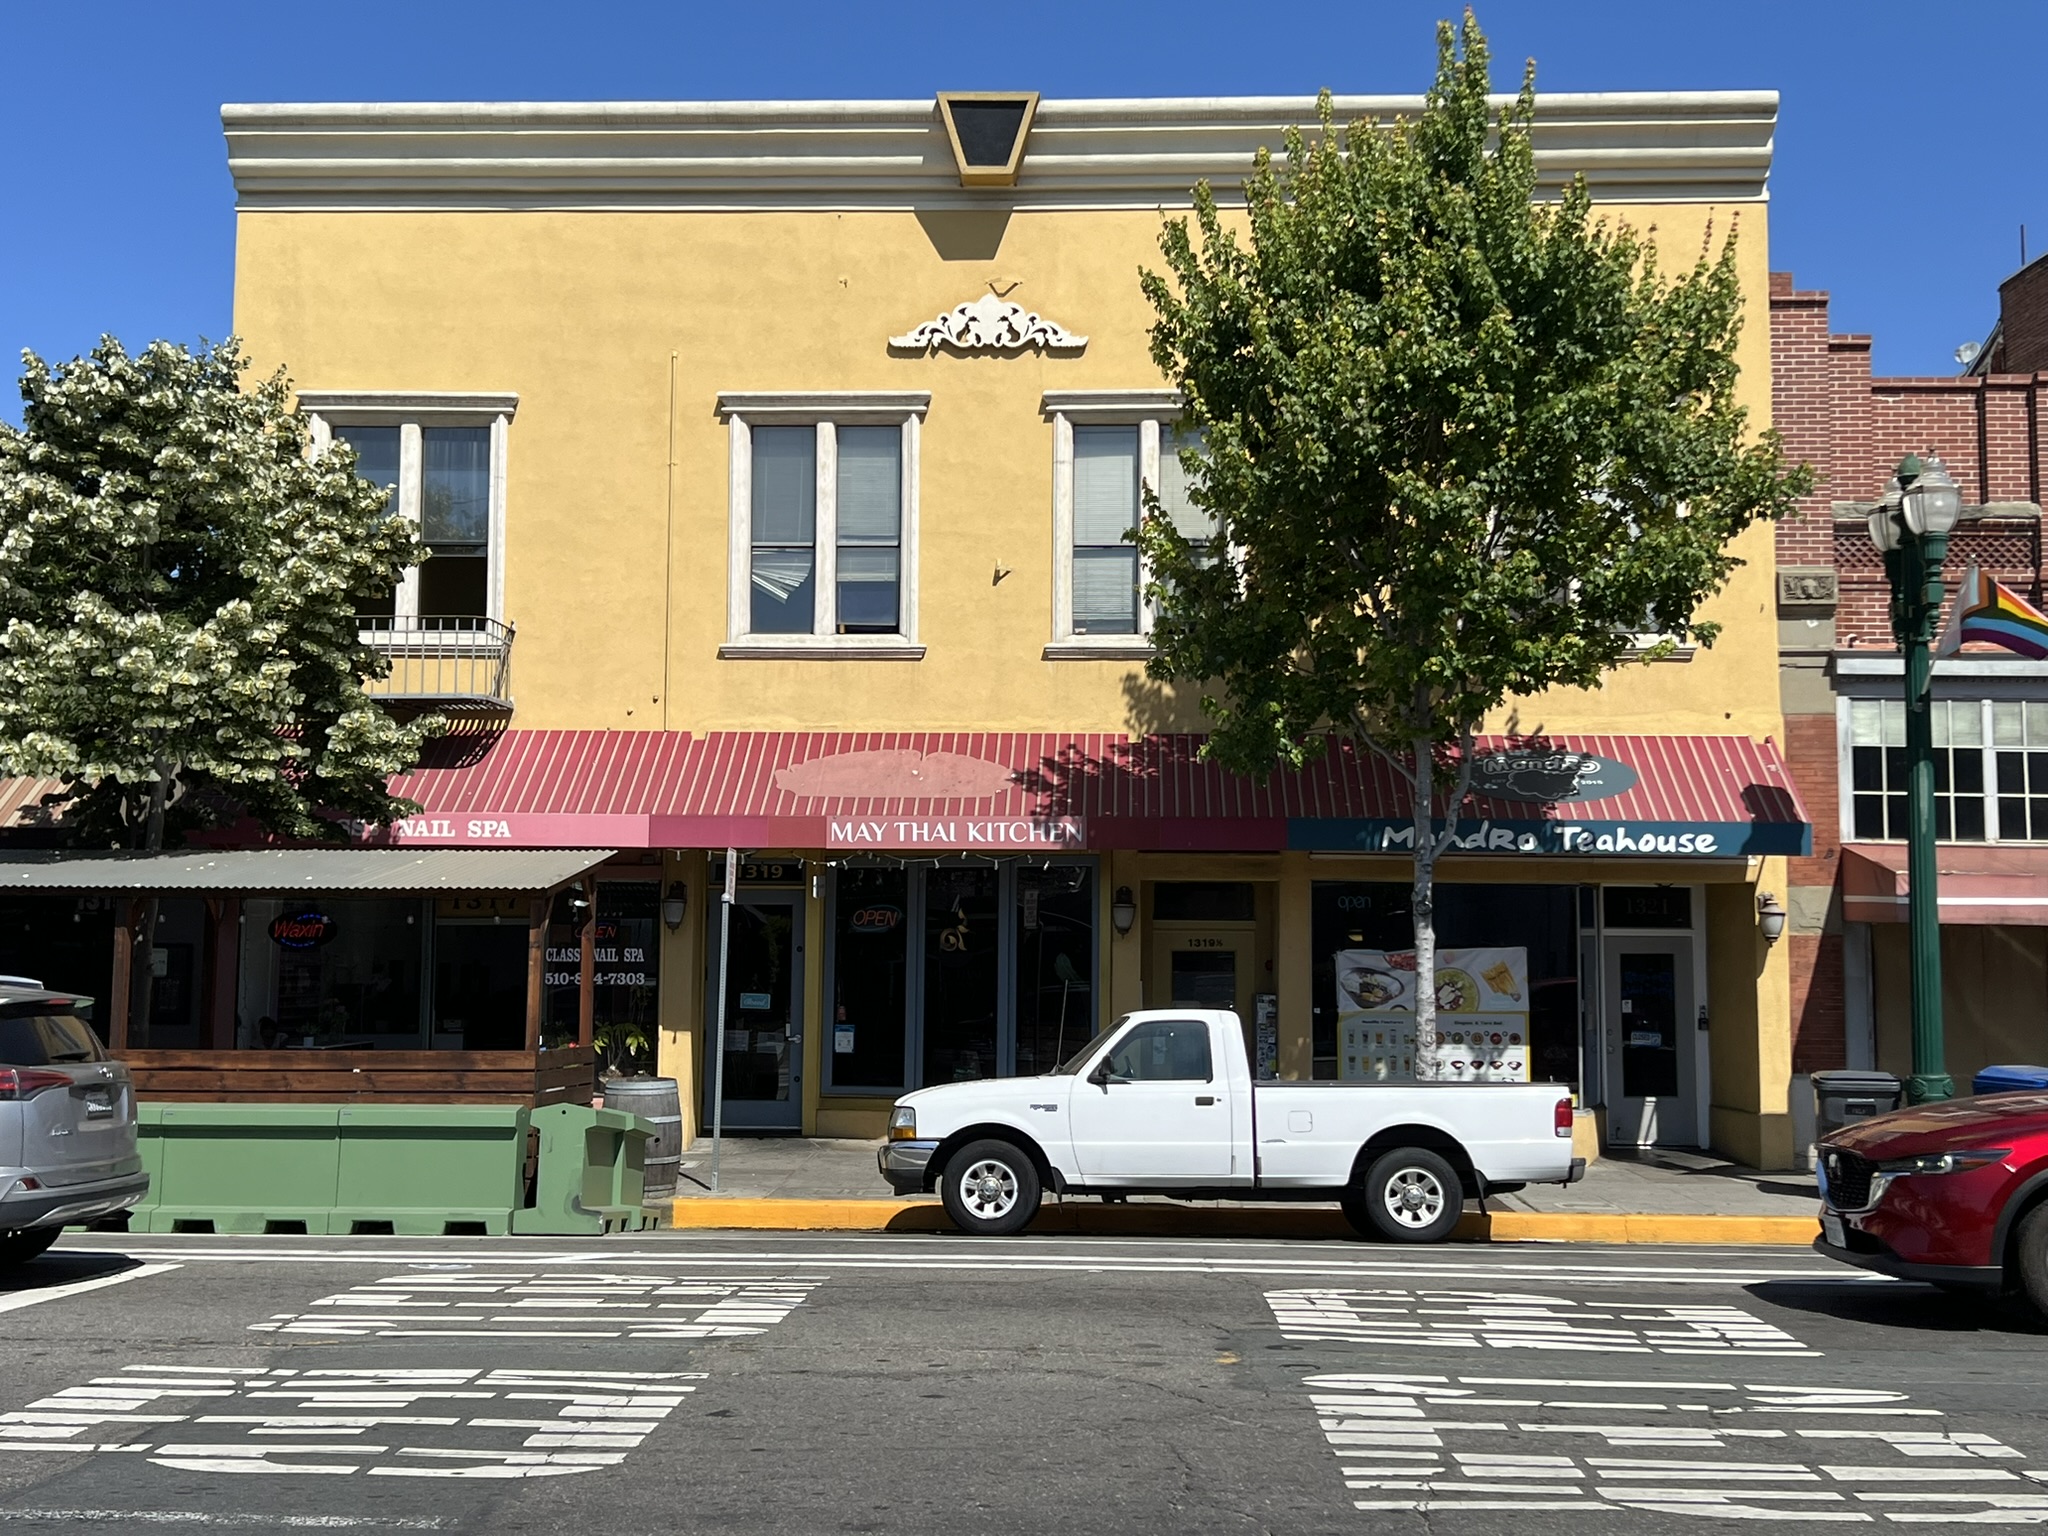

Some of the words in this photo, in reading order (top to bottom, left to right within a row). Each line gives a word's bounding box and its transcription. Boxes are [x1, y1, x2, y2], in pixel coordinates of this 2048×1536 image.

[398, 819, 456, 838] NAIL
[467, 819, 512, 838] SPA
[831, 821, 888, 843] MAY
[893, 821, 957, 843] THAI
[967, 821, 1084, 843] KITCHEN
[1381, 820, 1538, 851] MndRo
[1553, 825, 1720, 854] Teahouse
[1337, 896, 1371, 912] open
[853, 910, 898, 927] OPEN
[545, 948, 582, 962] CLASS
[623, 948, 645, 962] SPA
[545, 972, 646, 985] 510-84-7303
